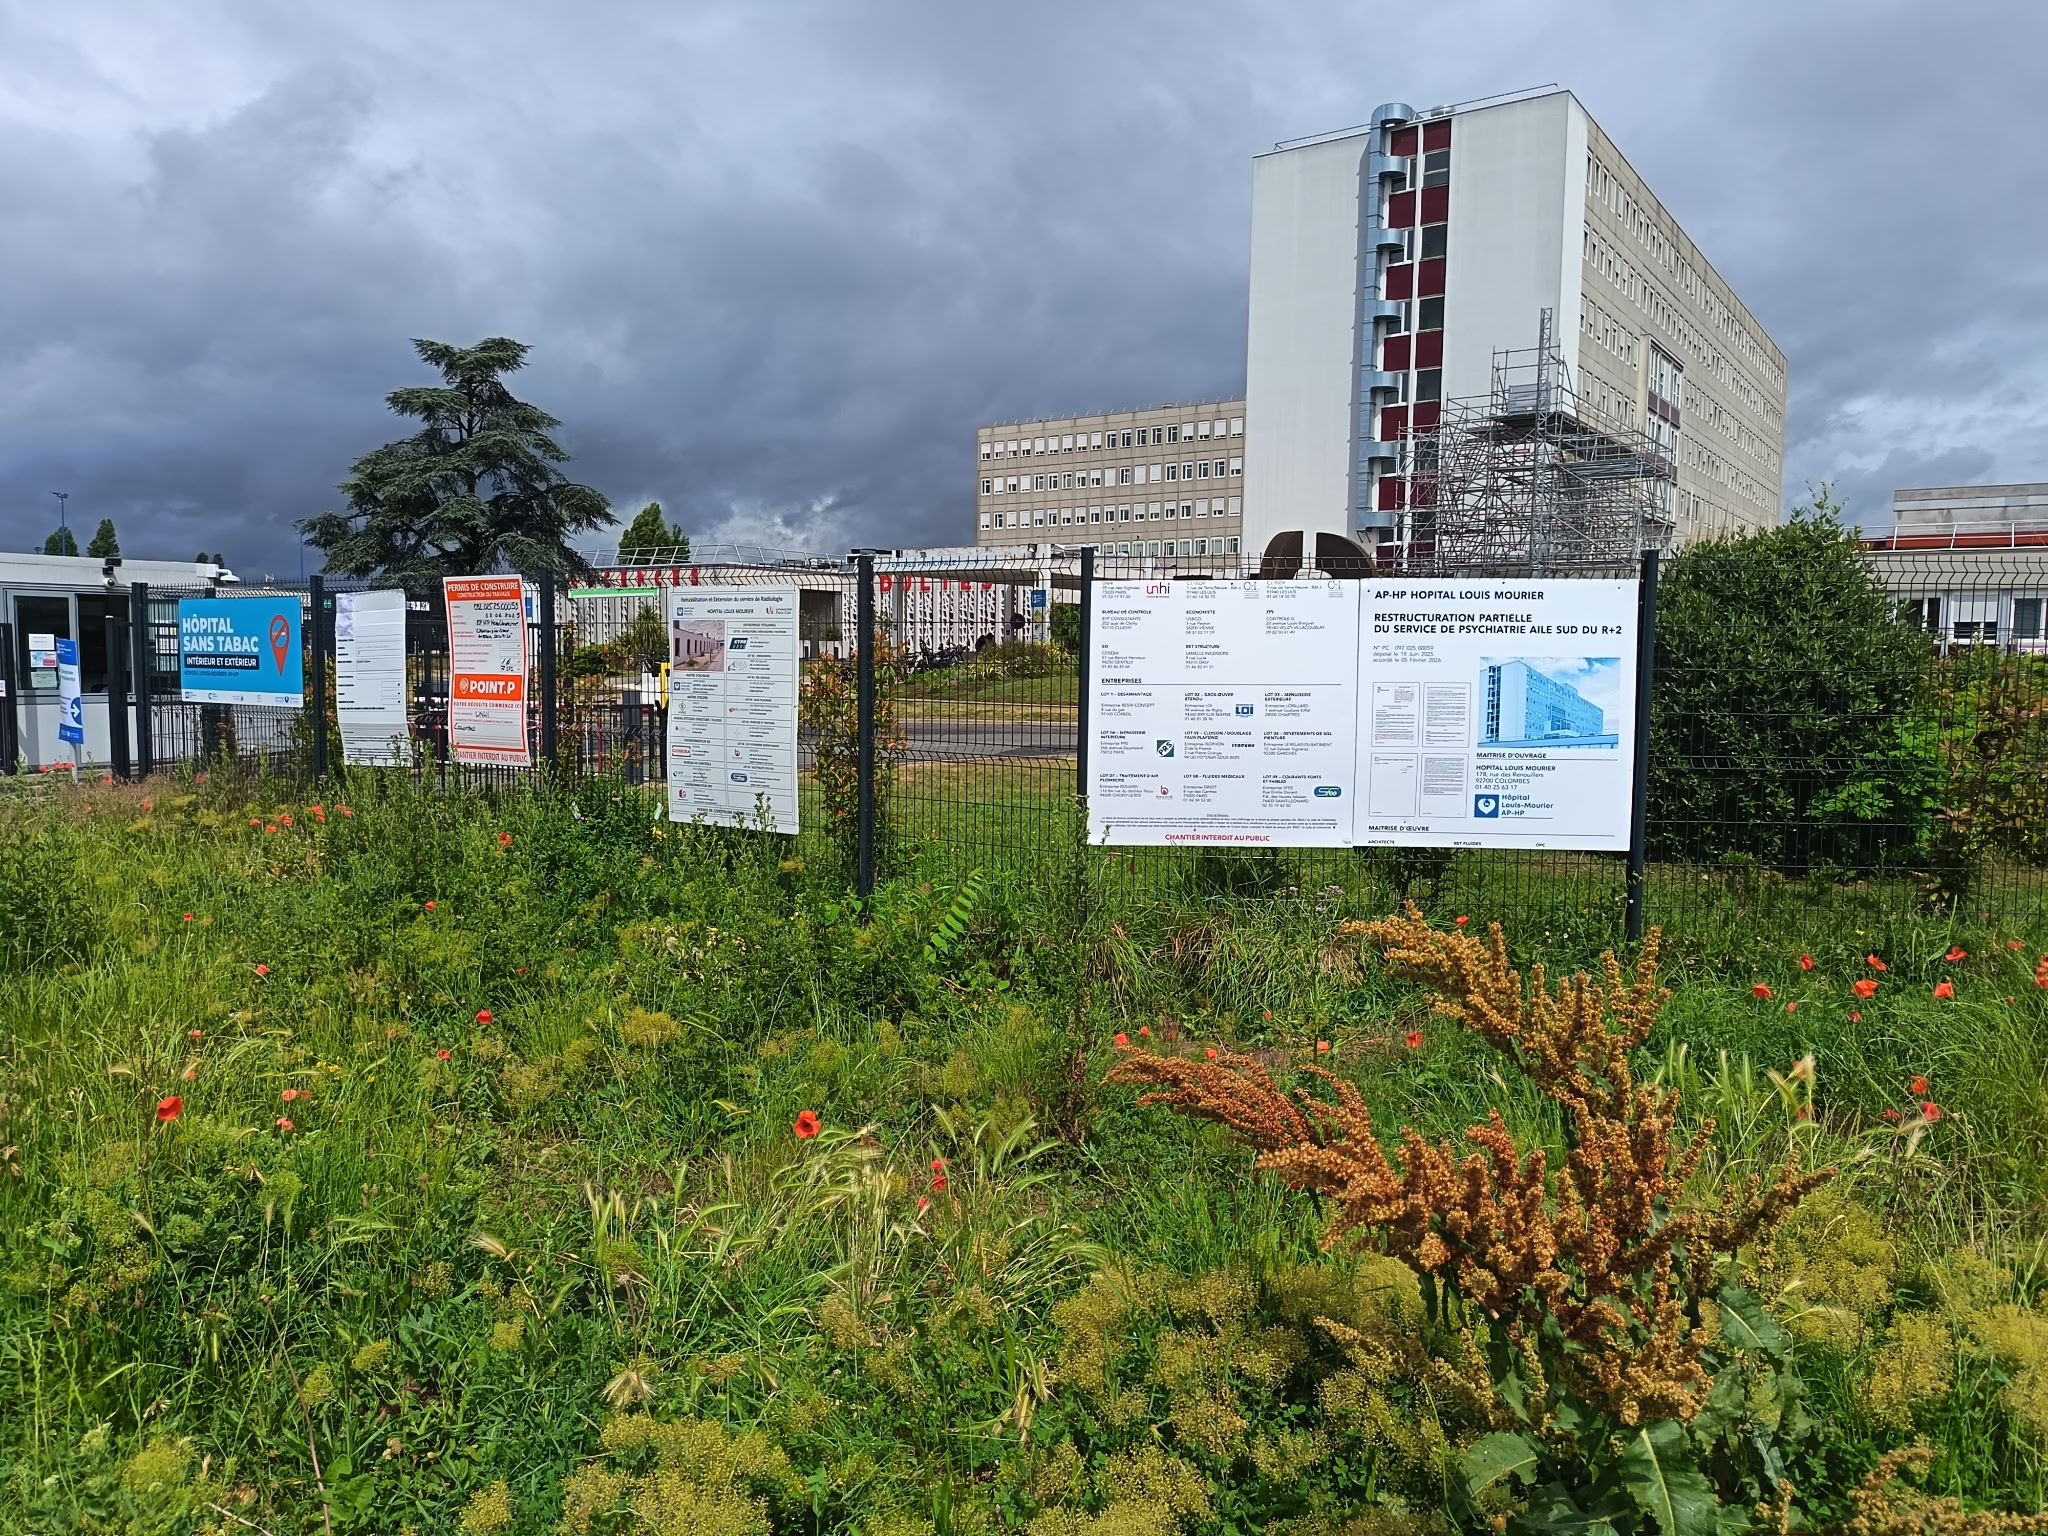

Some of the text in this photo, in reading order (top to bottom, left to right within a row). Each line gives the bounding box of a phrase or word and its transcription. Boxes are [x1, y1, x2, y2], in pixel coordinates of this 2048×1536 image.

[448, 583, 469, 592] PERMIS
[480, 582, 519, 590] CONSTRUIRE
[1146, 582, 1170, 594] unhi
[1374, 590, 1544, 601] AP-HP HOPITAL LOUIS MOURIER
[182, 613, 234, 633] HÔPITAL
[1374, 613, 1532, 623] RESTRUCTURATION PARTIELLE
[1374, 624, 1622, 635] DU SERVICE DE PSYCHIATRIE AILE SUD DU R+2
[184, 636, 259, 652] SANS TABAC
[186, 656, 215, 666] INTÉRIEUR
[224, 656, 256, 666] EXTÉRIEUR
[470, 681, 515, 694] POINT.P
[1236, 706, 1254, 715] LOI
[1158, 742, 1173, 756] PRS
[509, 754, 528, 762] PUBLIC
[1165, 833, 1201, 842] CHANTIER
[1201, 833, 1233, 842] INTERDIT
[1245, 833, 1270, 842] PUBLIC
